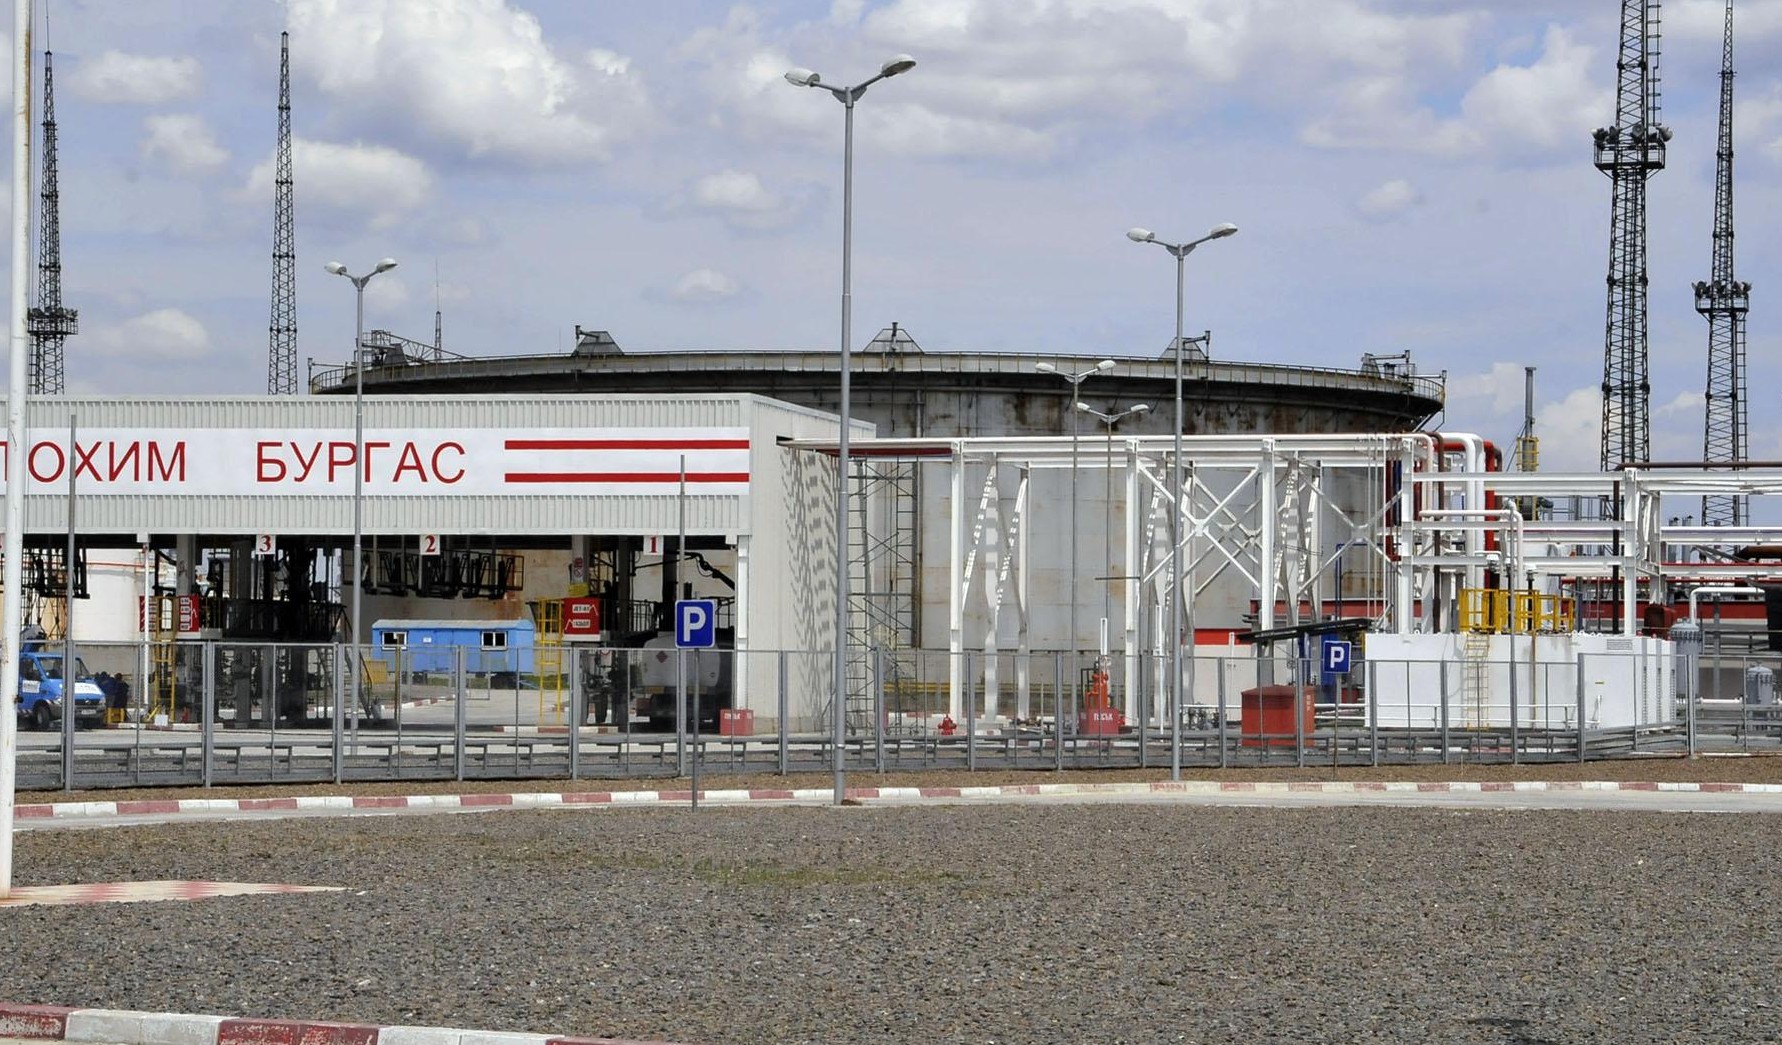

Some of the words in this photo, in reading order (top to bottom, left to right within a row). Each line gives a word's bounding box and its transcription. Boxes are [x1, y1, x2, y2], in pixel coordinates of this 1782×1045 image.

[256, 441, 466, 484] БУРГАС
[259, 535, 271, 552] 3
[425, 535, 436, 552] 2
[650, 536, 657, 553] 1
[683, 606, 706, 642] P
[1330, 646, 1345, 668] P
